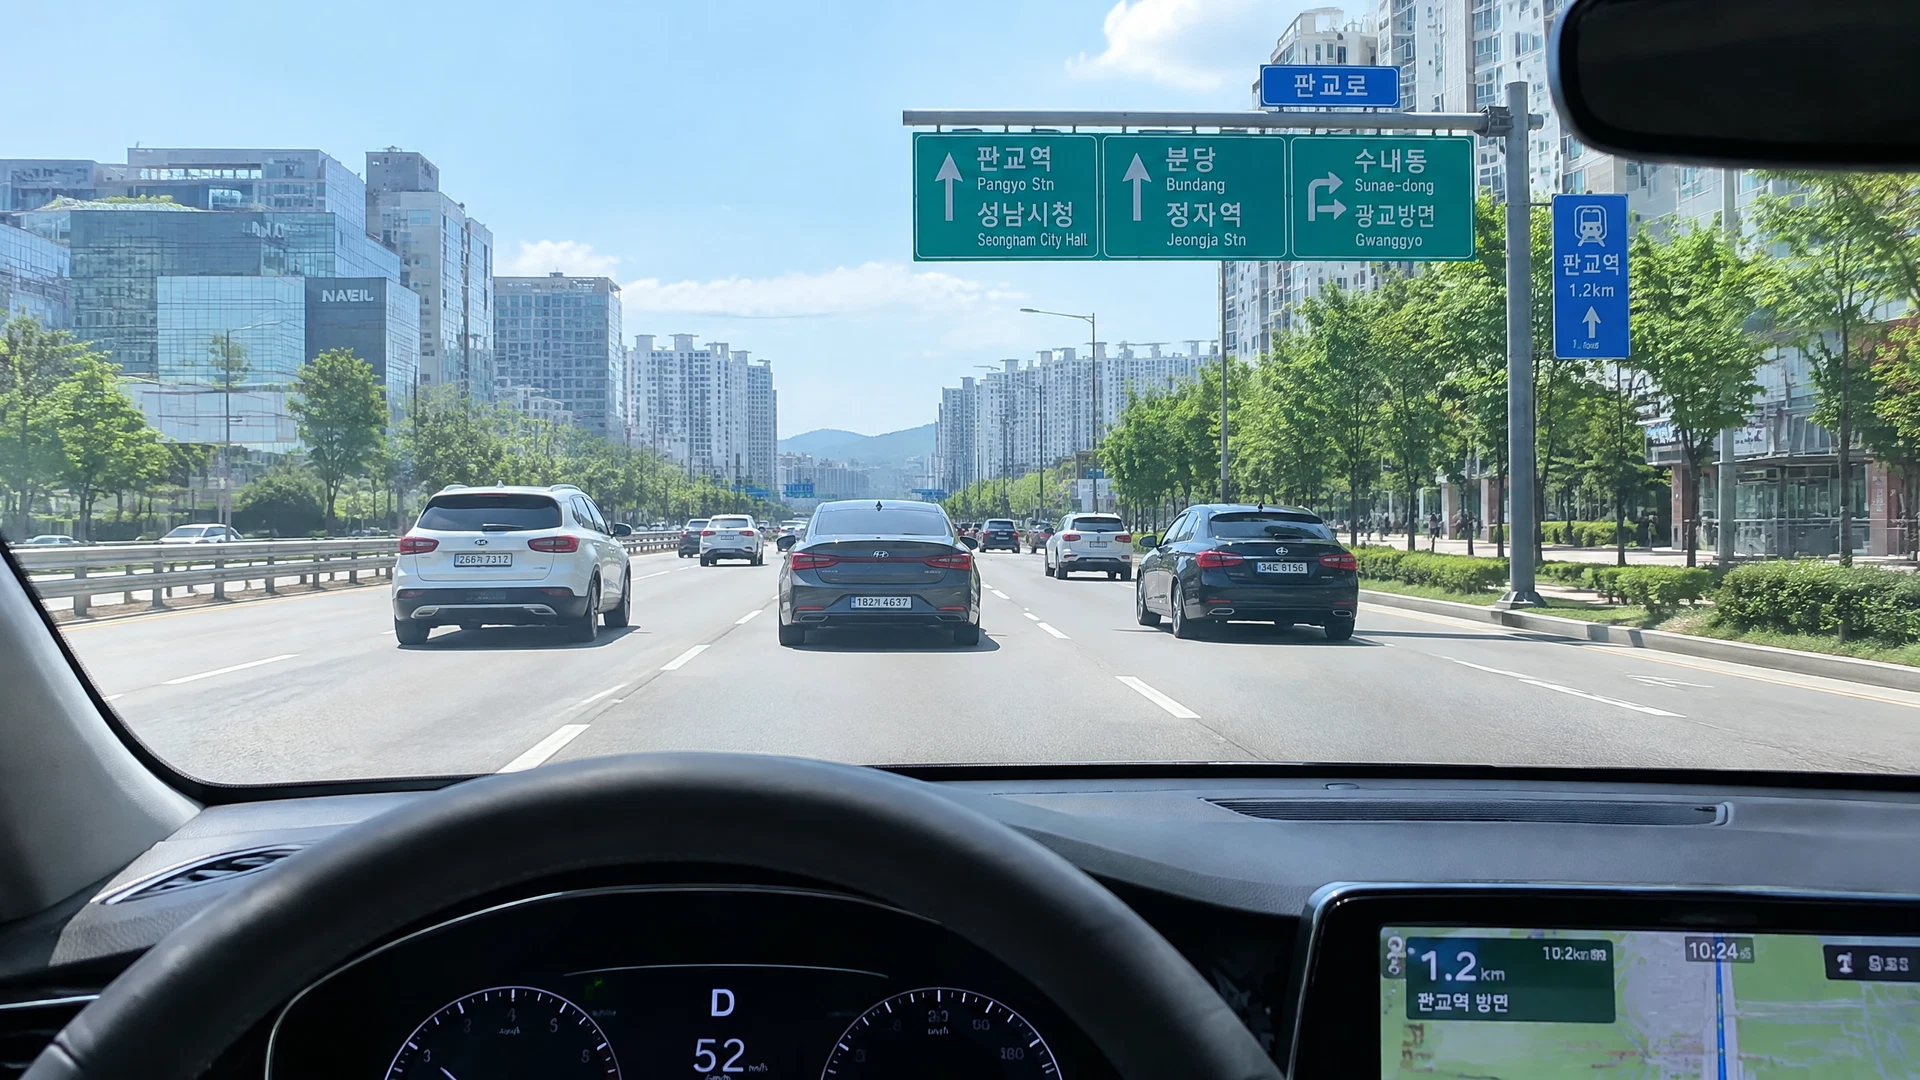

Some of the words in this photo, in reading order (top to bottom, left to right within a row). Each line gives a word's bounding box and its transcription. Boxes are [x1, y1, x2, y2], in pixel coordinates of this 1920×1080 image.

[1294, 73, 1368, 97] 판교로
[977, 146, 1050, 172] 판교역
[1166, 147, 1216, 172] 분당
[1355, 149, 1427, 173] 수내동
[977, 177, 1026, 193] Pangyo
[1032, 177, 1054, 190] Stn
[1167, 178, 1225, 194] Bundang
[1355, 178, 1434, 195] Sunae-dong
[977, 201, 1073, 228] 성남시청
[1166, 202, 1241, 227] 정자역
[1355, 204, 1434, 228] 광교방면
[1040, 233, 1062, 249] City
[1066, 233, 1087, 246] Hall
[1167, 233, 1218, 249] Jeongja
[1224, 233, 1247, 246] Stn
[1355, 233, 1423, 249] Gwanggyo
[1563, 253, 1619, 276] 판교역
[1569, 283, 1614, 297] 1.2km
[485, 555, 509, 564] 7312
[883, 597, 908, 607] 4637
[1689, 942, 1739, 960] 10:24
[1420, 950, 1477, 981] 1.2
[1480, 967, 1506, 981] km
[711, 988, 735, 1017] D
[1418, 992, 1469, 1012] 판교역
[693, 1038, 745, 1072] 52
